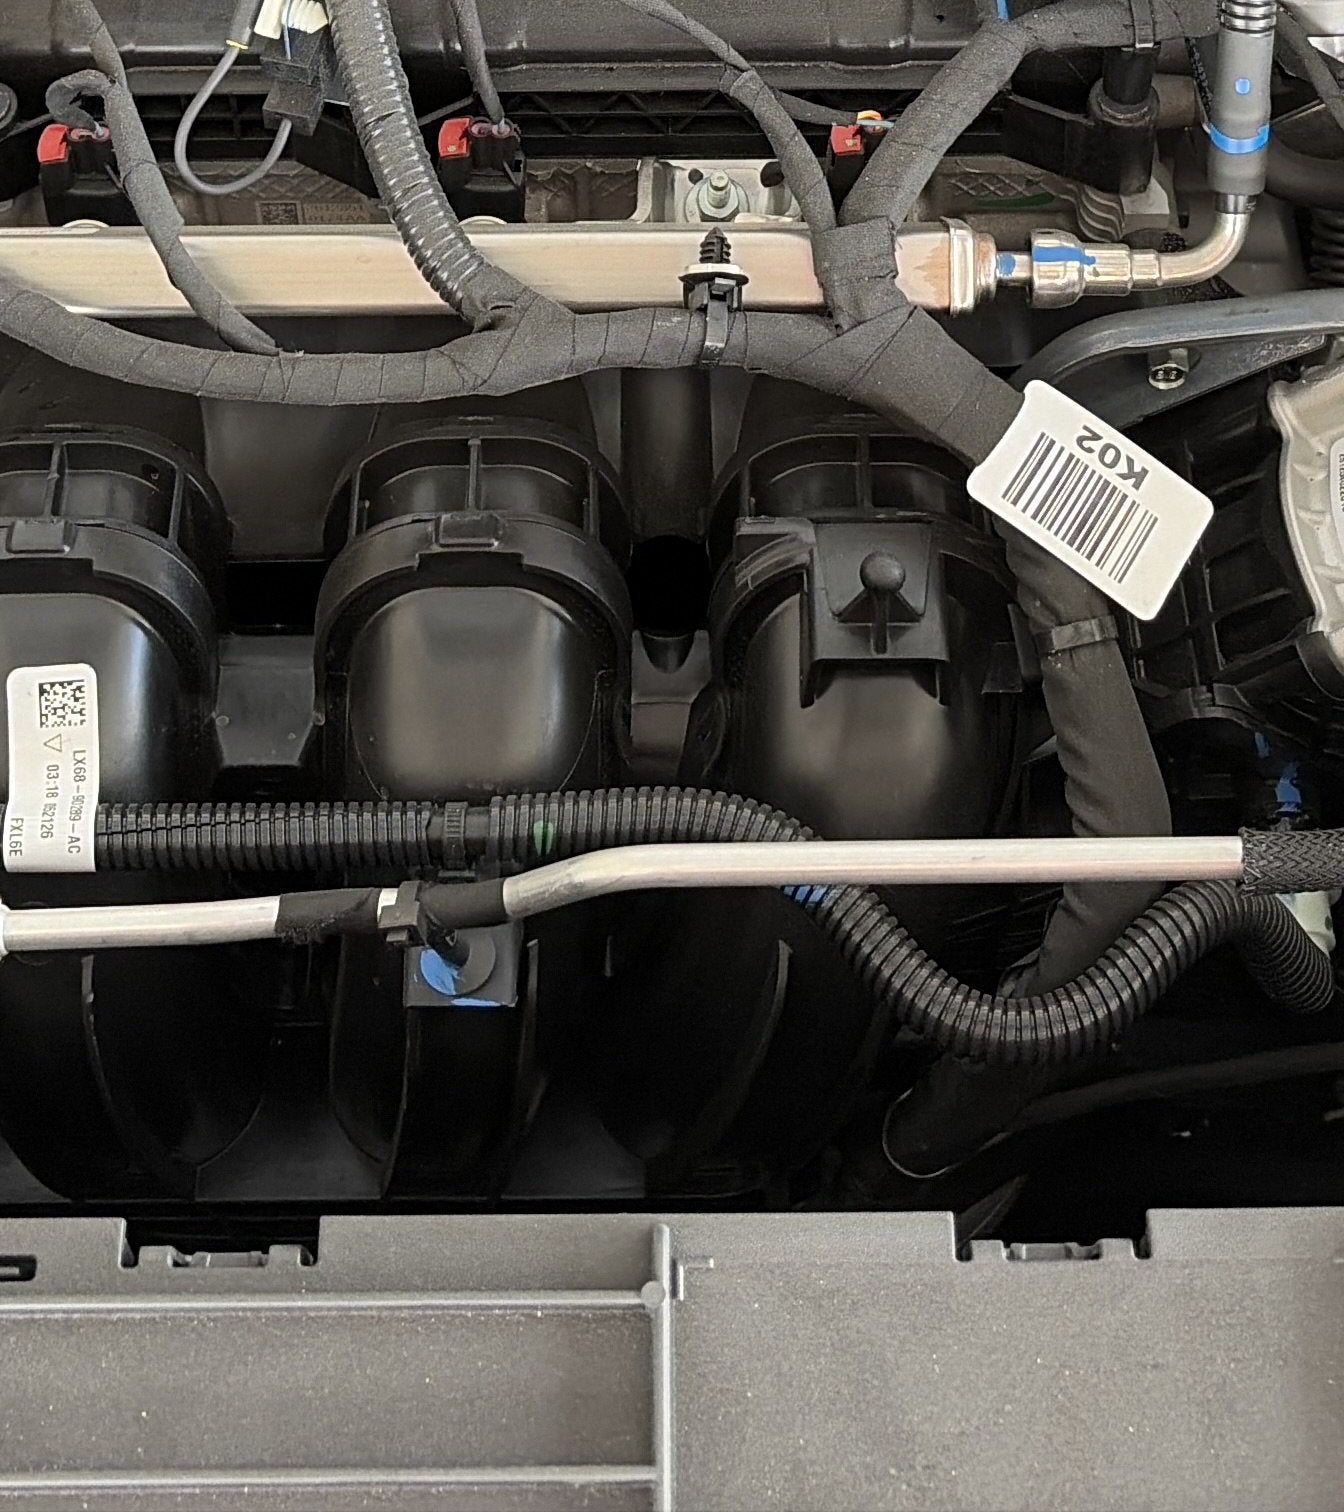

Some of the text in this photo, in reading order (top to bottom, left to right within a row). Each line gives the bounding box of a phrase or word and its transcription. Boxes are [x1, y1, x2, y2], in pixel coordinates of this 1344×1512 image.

[1076, 425, 1149, 491] K02
[45, 764, 60, 799] 03:18
[8, 817, 25, 857] FXL6E
